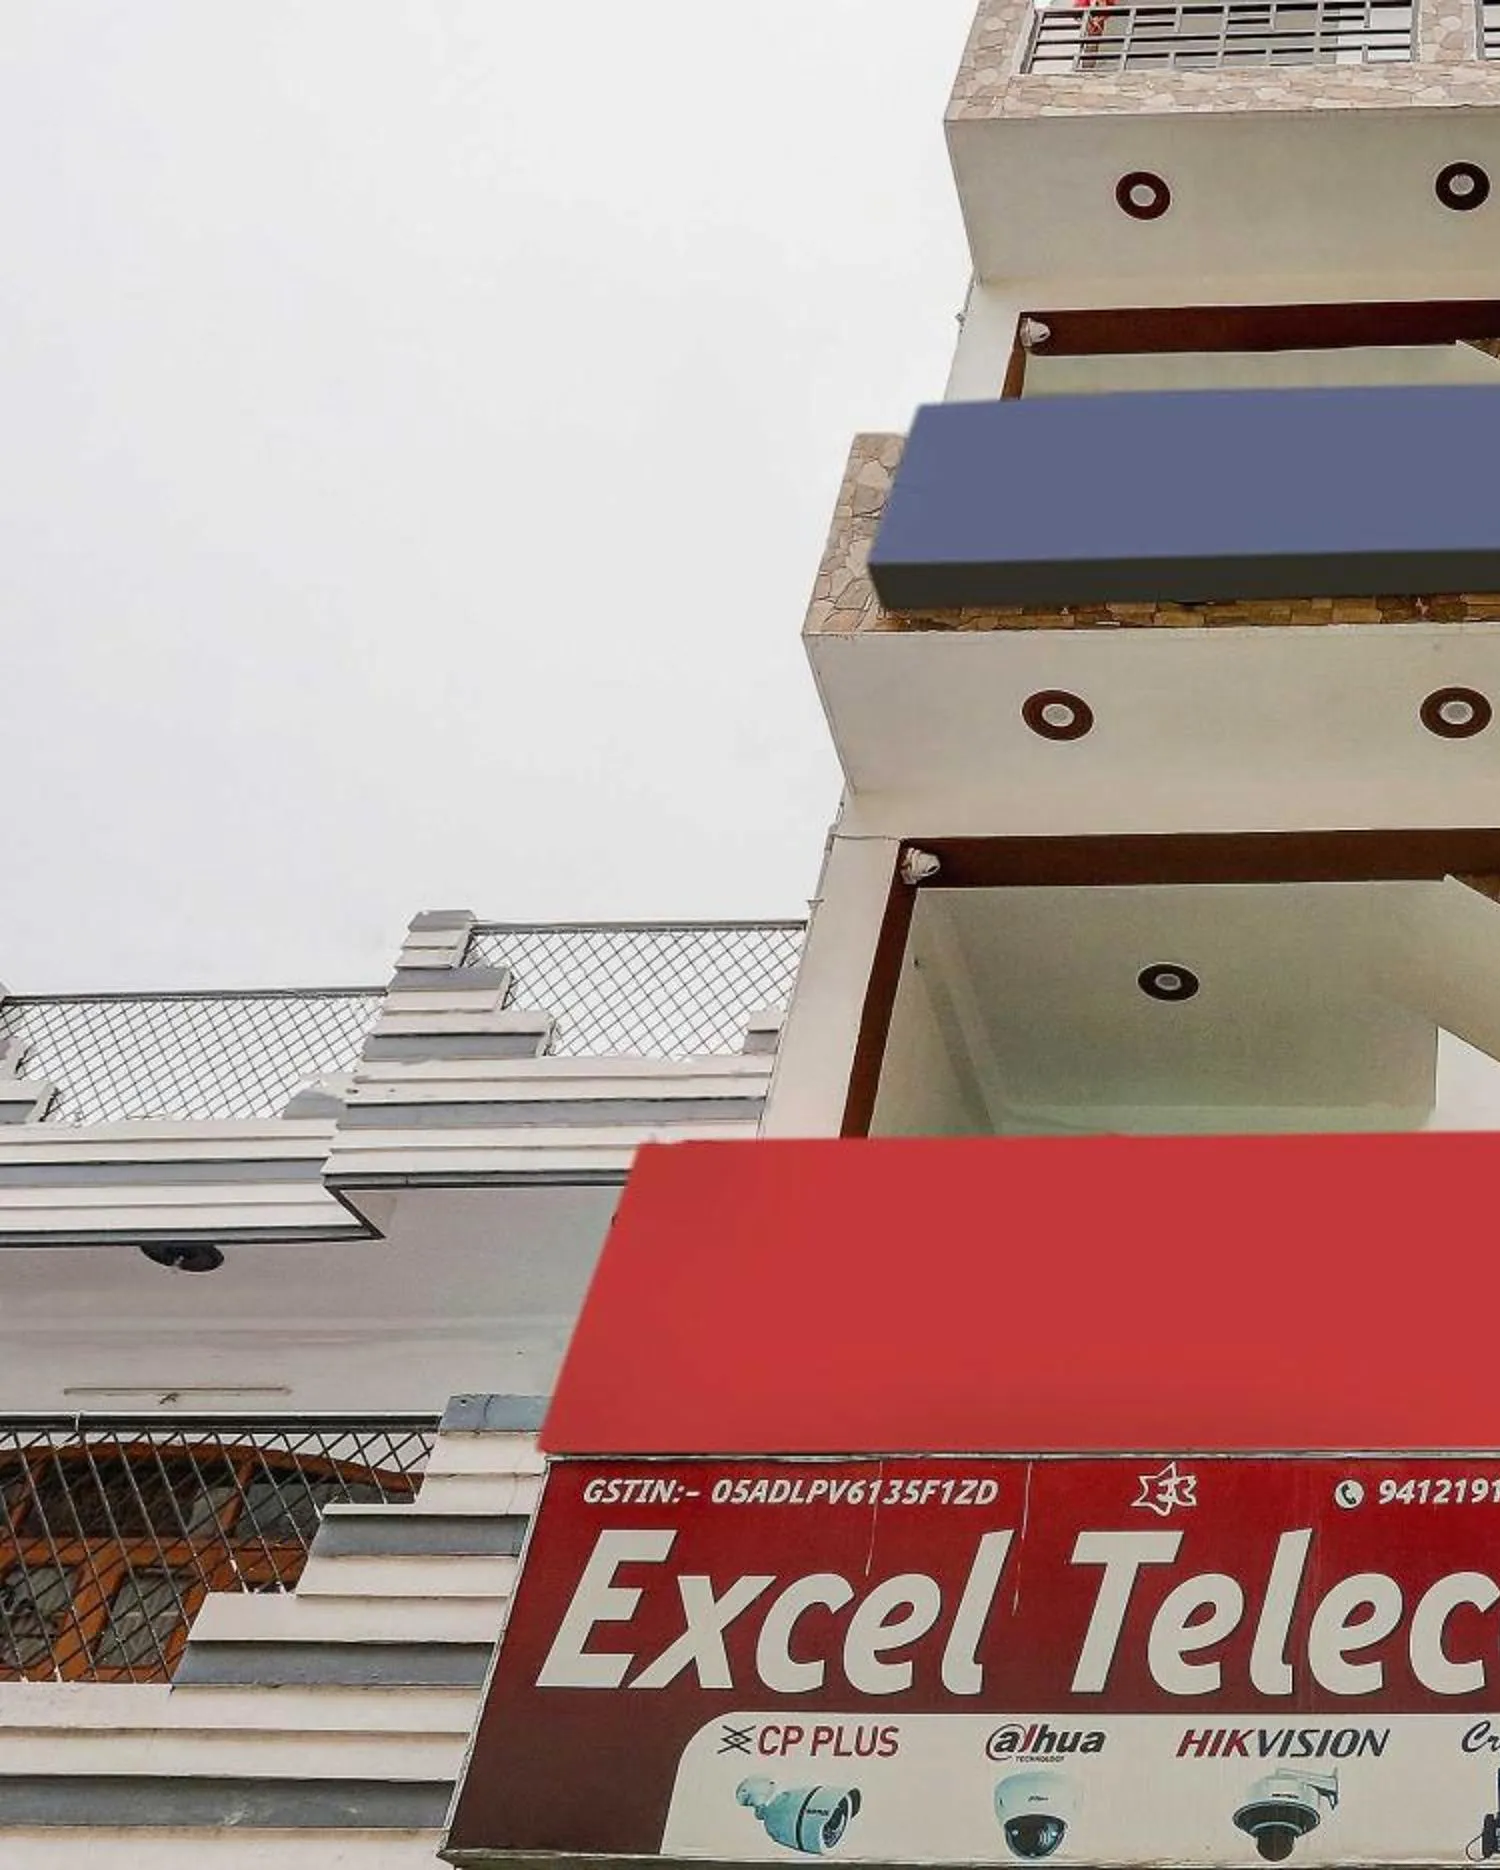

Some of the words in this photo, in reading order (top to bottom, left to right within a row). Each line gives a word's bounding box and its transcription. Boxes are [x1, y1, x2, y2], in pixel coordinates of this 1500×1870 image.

[535, 1528, 1014, 1696] Excel
[757, 1725, 804, 1756] CP
[810, 1725, 900, 1757] PLUS
[1175, 1728, 1391, 1757] HIKVISION
